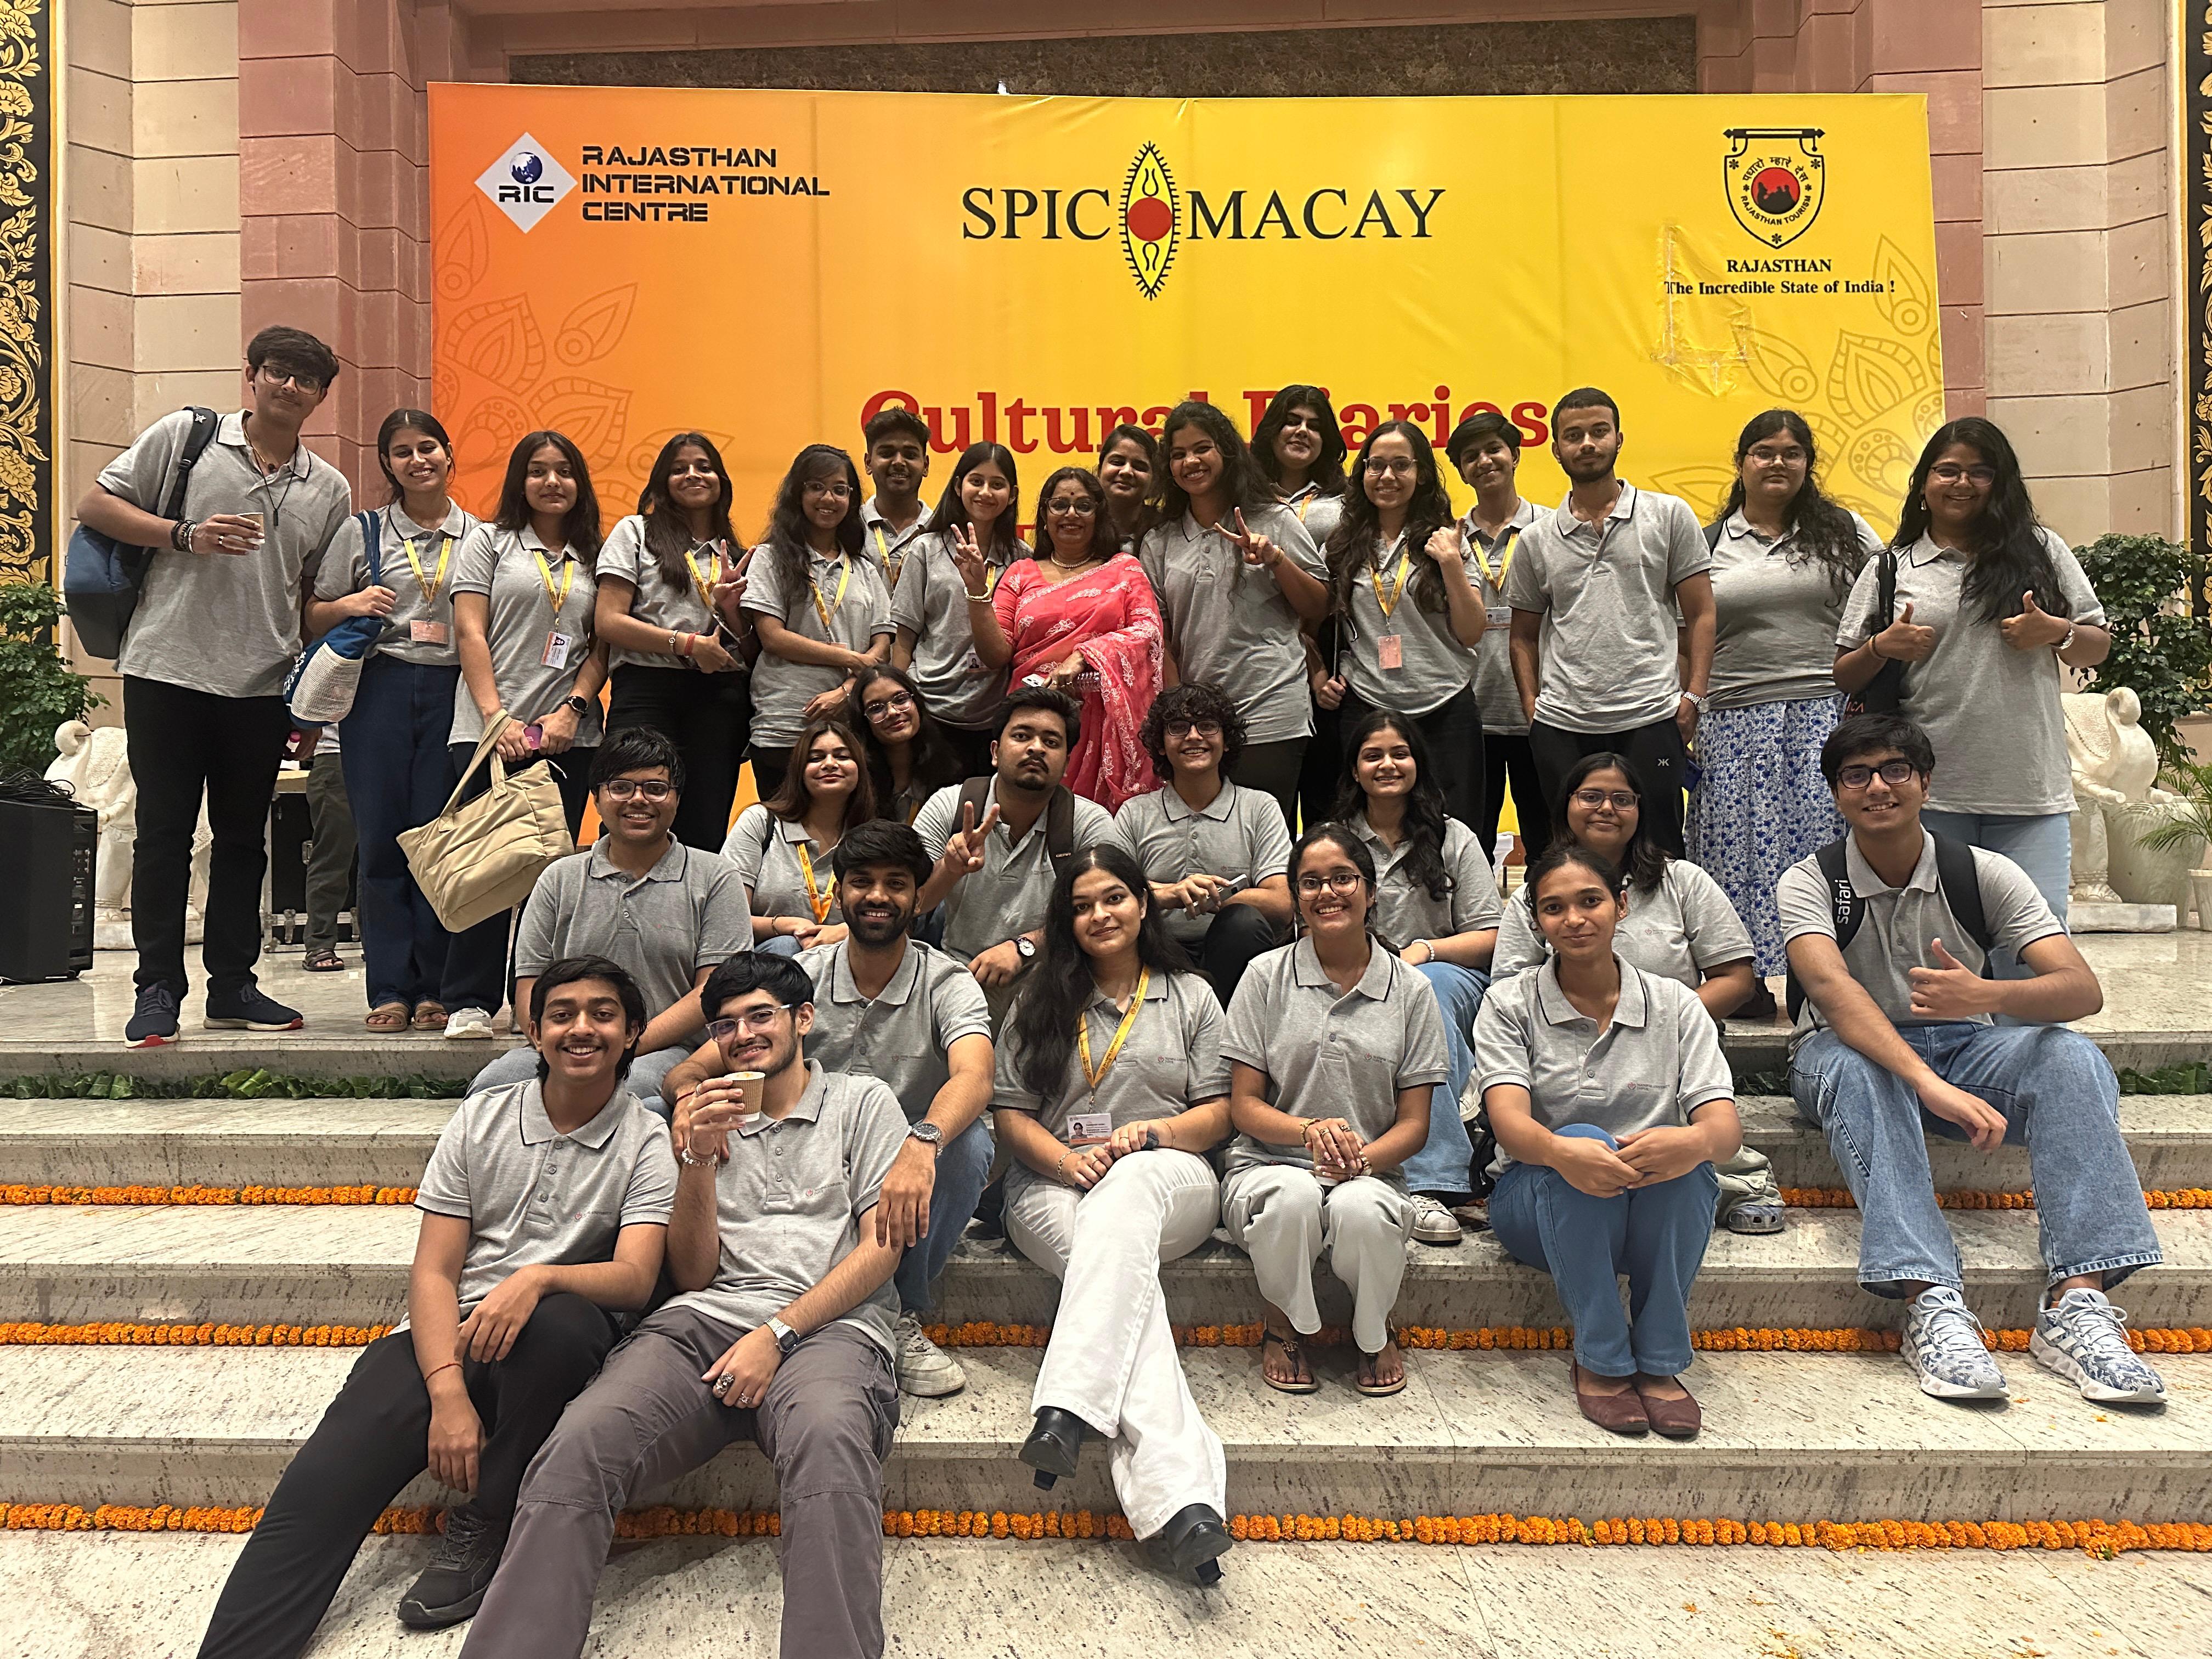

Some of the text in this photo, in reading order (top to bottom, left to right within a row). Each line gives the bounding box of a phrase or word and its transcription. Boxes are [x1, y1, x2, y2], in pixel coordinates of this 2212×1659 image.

[583, 145, 776, 167] RAJASTHAN
[499, 185, 554, 203] RIC
[582, 173, 830, 196] INTERNATIONAL
[582, 201, 708, 222] CENTRE
[962, 188, 1446, 240] SPIC MACAY
[1741, 195, 1811, 225] RAJASTHAN TOURISM
[1726, 259, 1832, 273] RAJASTHAN
[1664, 281, 1693, 295] The
[1699, 281, 1775, 295] Incredible
[1781, 281, 1818, 294] State
[1824, 280, 1839, 294] of
[1845, 280, 1884, 294] India
[1835, 879, 1851, 924] safari
